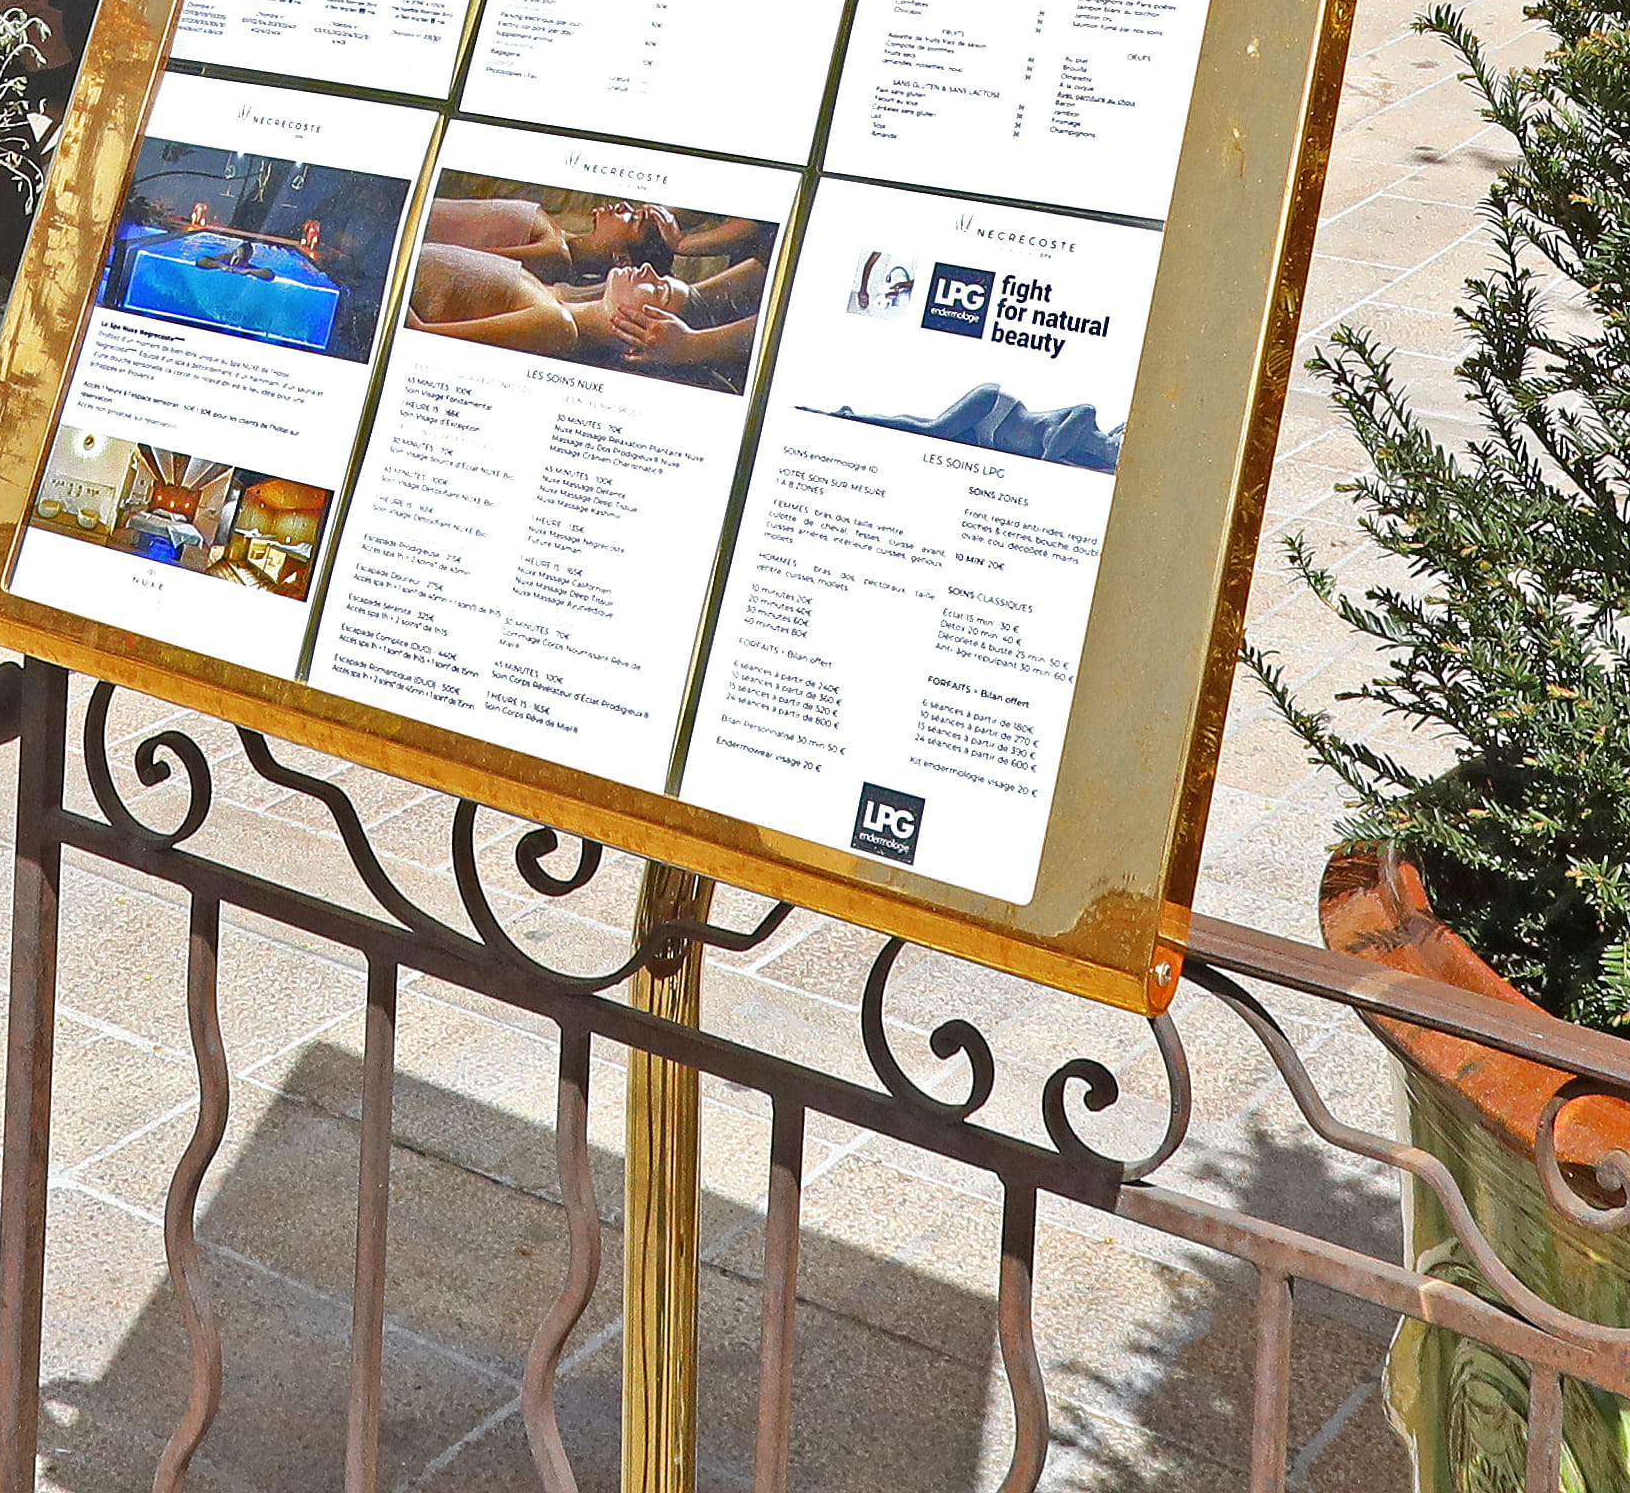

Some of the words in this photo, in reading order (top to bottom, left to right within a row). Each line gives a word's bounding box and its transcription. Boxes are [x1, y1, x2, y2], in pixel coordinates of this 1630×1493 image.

[976, 227, 1076, 253] NEGRECOSTE
[933, 277, 986, 310] LPG
[1000, 273, 1053, 303] fight
[930, 307, 979, 323] endermologie
[995, 296, 1028, 323] for
[1030, 308, 1110, 338] natural
[989, 319, 1066, 360] beauty
[525, 368, 544, 381] LES
[545, 371, 575, 387] SOINS
[576, 378, 604, 394] NUXE
[922, 452, 943, 466] LES
[945, 456, 980, 474] SOINS
[967, 485, 996, 499] SOINS
[996, 491, 1029, 507] ZONES
[975, 592, 1033, 614] CLASSIQUES
[862, 799, 914, 839] LPG
[858, 831, 909, 853] endermologie
